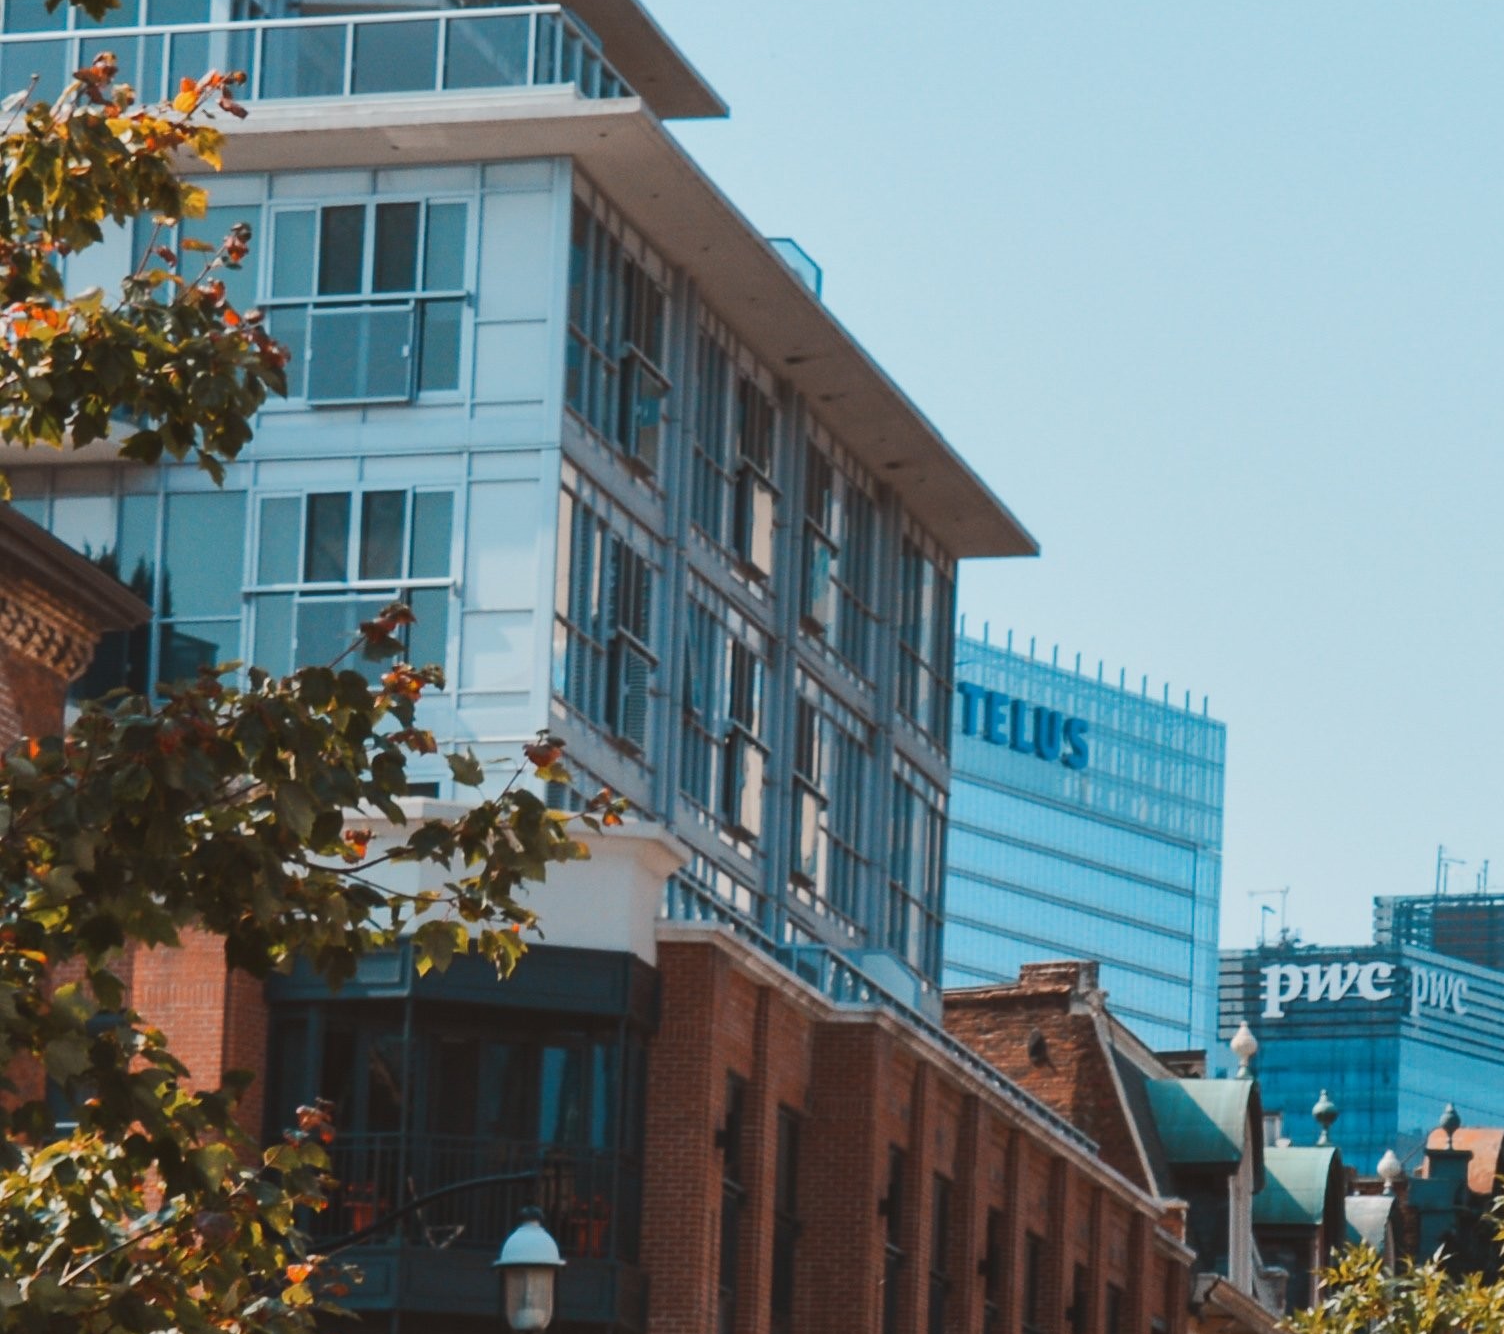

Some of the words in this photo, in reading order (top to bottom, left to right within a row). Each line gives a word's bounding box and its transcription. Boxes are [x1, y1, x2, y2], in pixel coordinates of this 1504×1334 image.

[957, 681, 1089, 771] TELUS
[1260, 961, 1392, 1018] pwc
[1410, 966, 1468, 1017] pwc
